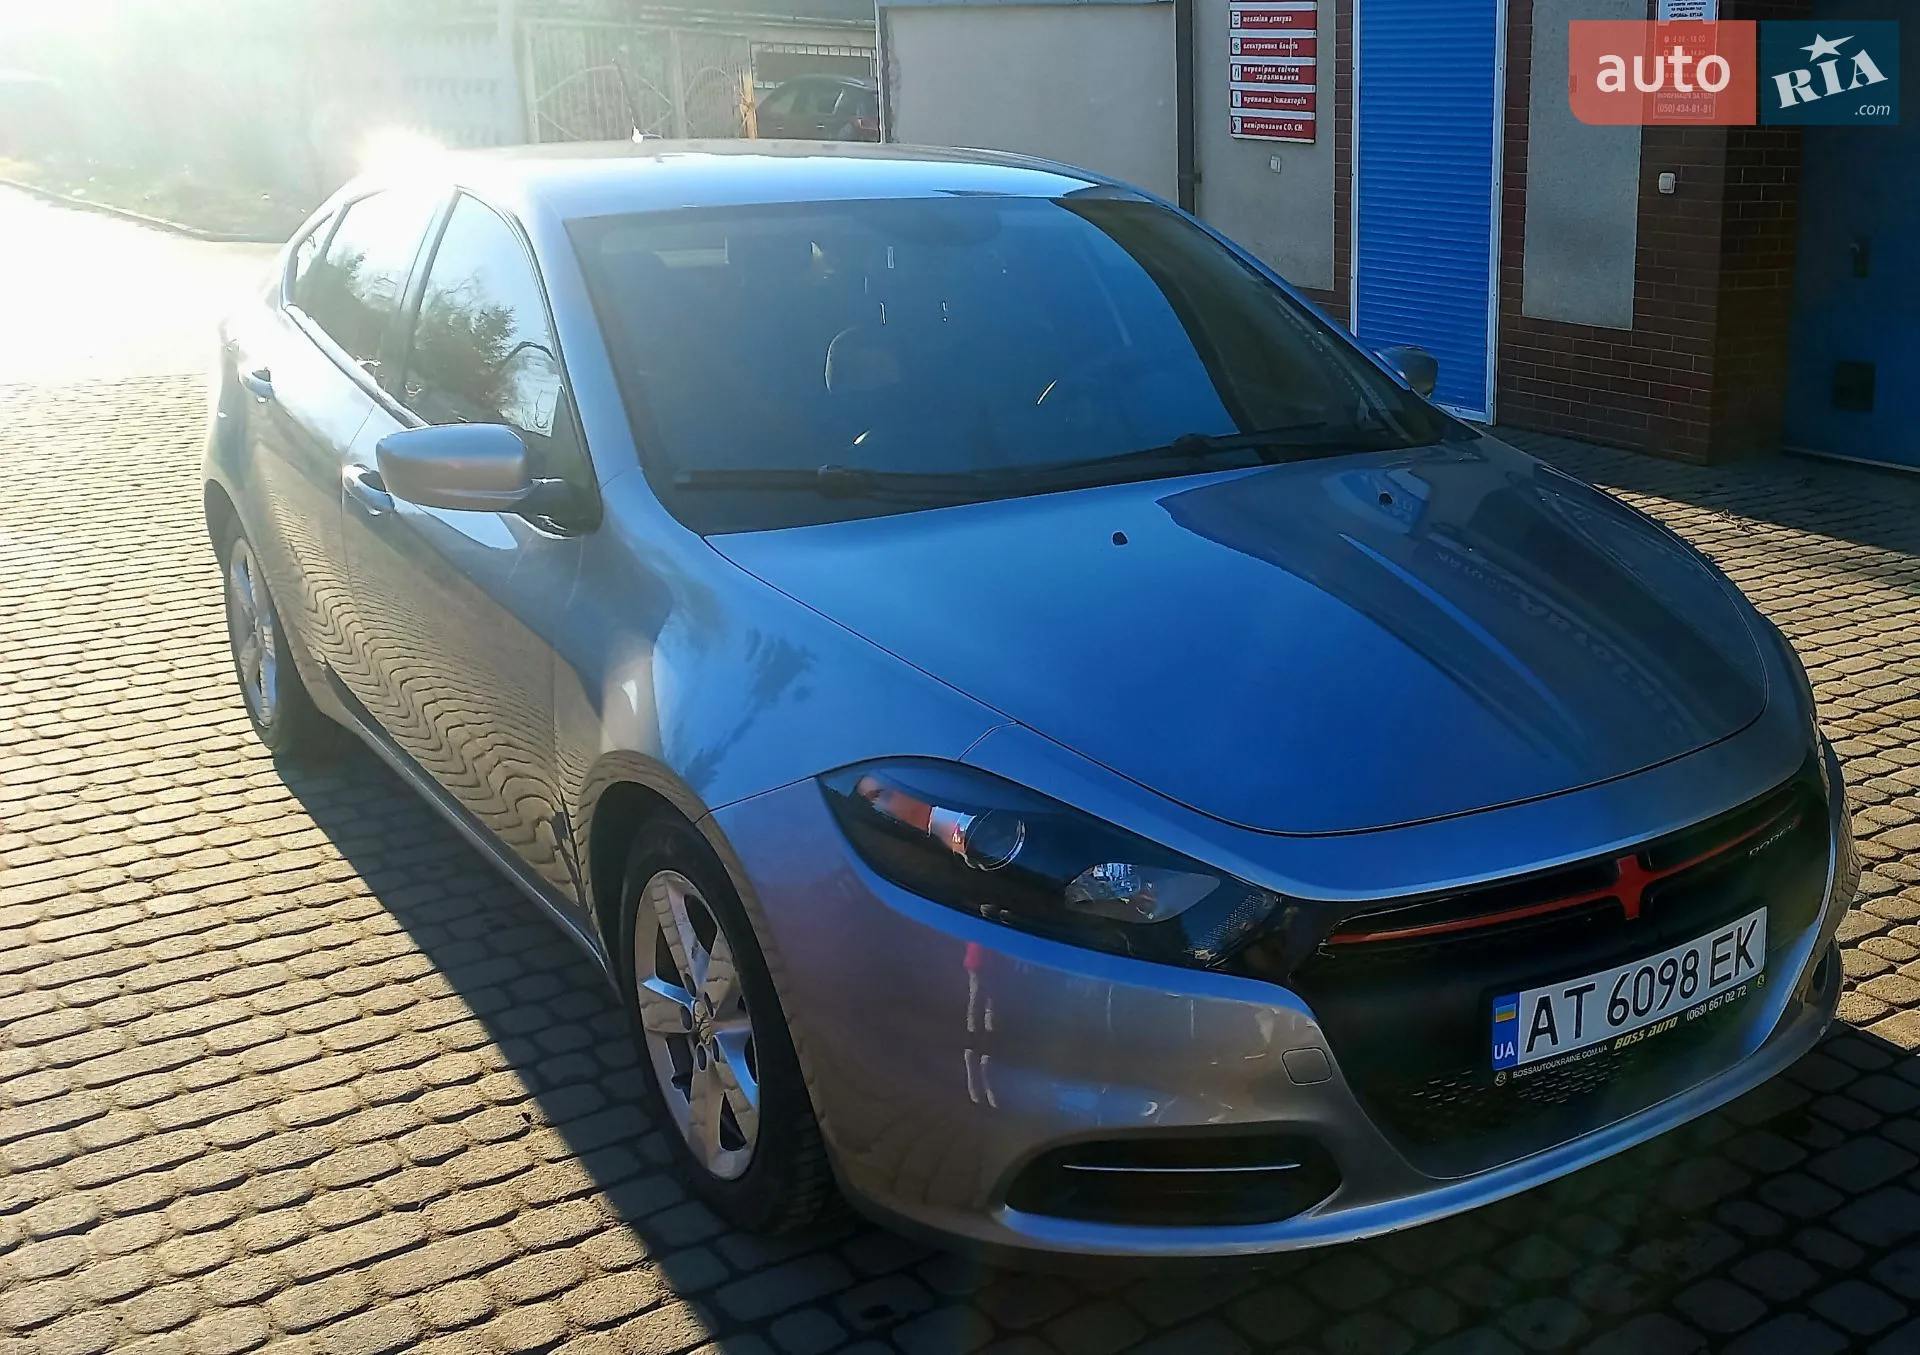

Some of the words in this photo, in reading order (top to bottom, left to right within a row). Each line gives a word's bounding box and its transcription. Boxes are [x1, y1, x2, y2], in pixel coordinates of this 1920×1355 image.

[1657, 103, 1675, 113] (050)
[1525, 982, 1596, 1053] AT
[1607, 949, 1700, 1027] 6098
[1708, 918, 1758, 990] EK
[1613, 1030, 1645, 1050] BOSS
[1647, 1016, 1679, 1038] AUTO
[1686, 1004, 1707, 1022] (063)
[1708, 998, 1724, 1012] 667
[1725, 992, 1736, 1003] 02
[1736, 985, 1748, 997] 72
[1494, 1041, 1515, 1061] UA
